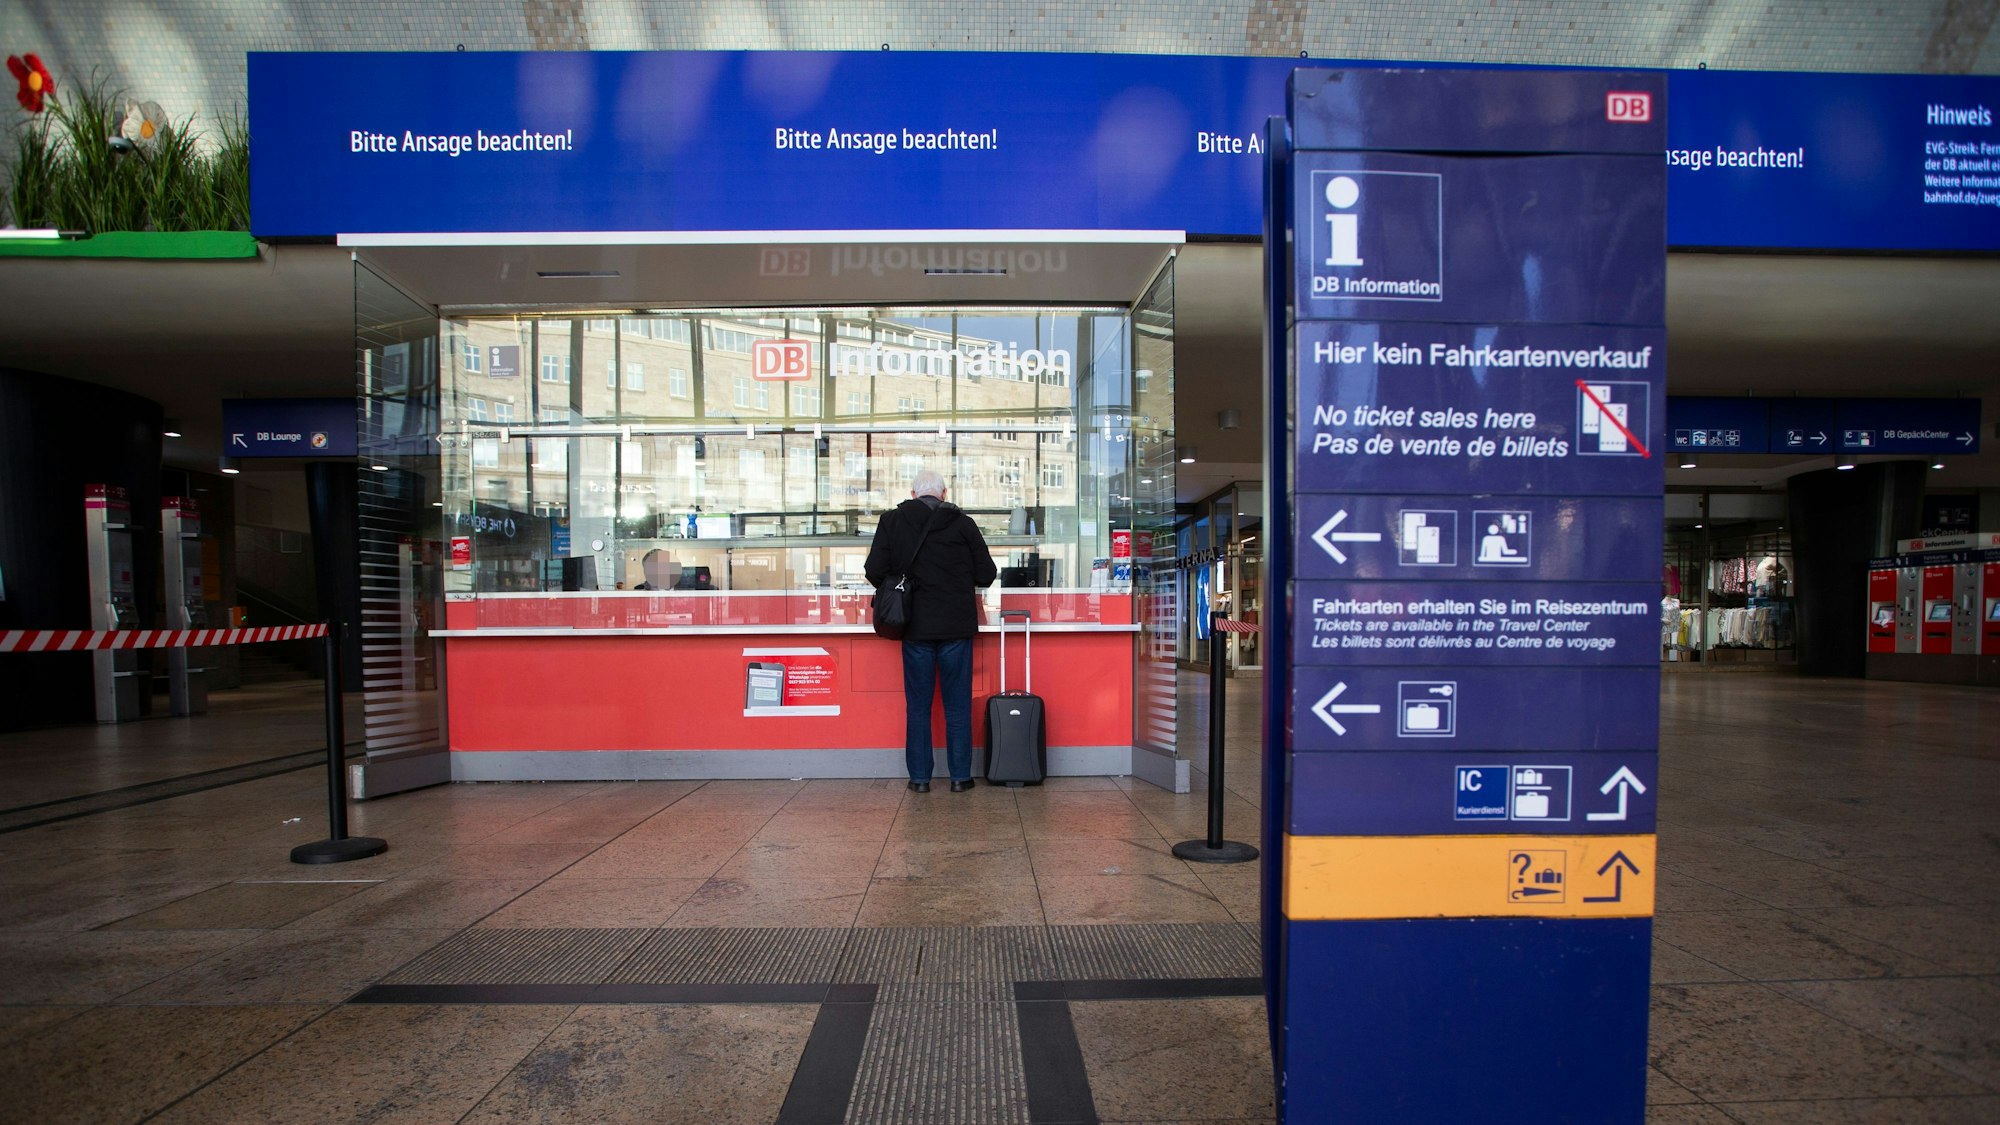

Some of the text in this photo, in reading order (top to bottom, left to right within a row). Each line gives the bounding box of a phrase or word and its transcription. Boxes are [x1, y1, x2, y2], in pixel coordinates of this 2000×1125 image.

[1610, 95, 1649, 119] DB
[1927, 103, 1992, 126] Hinweis
[351, 129, 573, 157] Bitte Ansage beachten!
[775, 128, 998, 154] Bitte Ansage beachten!
[1198, 131, 1243, 153] Bitte
[1925, 141, 1979, 155] EVG-Streik:
[1716, 146, 1804, 168] beachten!
[1924, 159, 1941, 171] der
[1943, 159, 1957, 171] DB
[1958, 159, 1990, 172] aktuell
[1924, 174, 1961, 187] Weitere
[1313, 276, 1441, 296] DB Information
[757, 341, 1071, 377] DB Information
[1313, 341, 1651, 369] Hier kein Fahrkartenverkauf
[1313, 405, 1536, 429] No ticket sales here
[257, 432, 302, 443] DB Lounge
[1312, 433, 1569, 457] Pas de vente de billets
[1884, 430, 1950, 440] DB GepäckCenter
[1924, 539, 1966, 548] Information
[1312, 598, 1649, 615] Fahrkarten erhalten Sie im Reisezentrum
[1314, 617, 1591, 632] Tickets are available in the Travel Center
[1312, 634, 1616, 651] Les billets sont délivrés au Centre de voyage
[1460, 769, 1482, 792] IC
[1457, 805, 1505, 815] Kurierdienst
